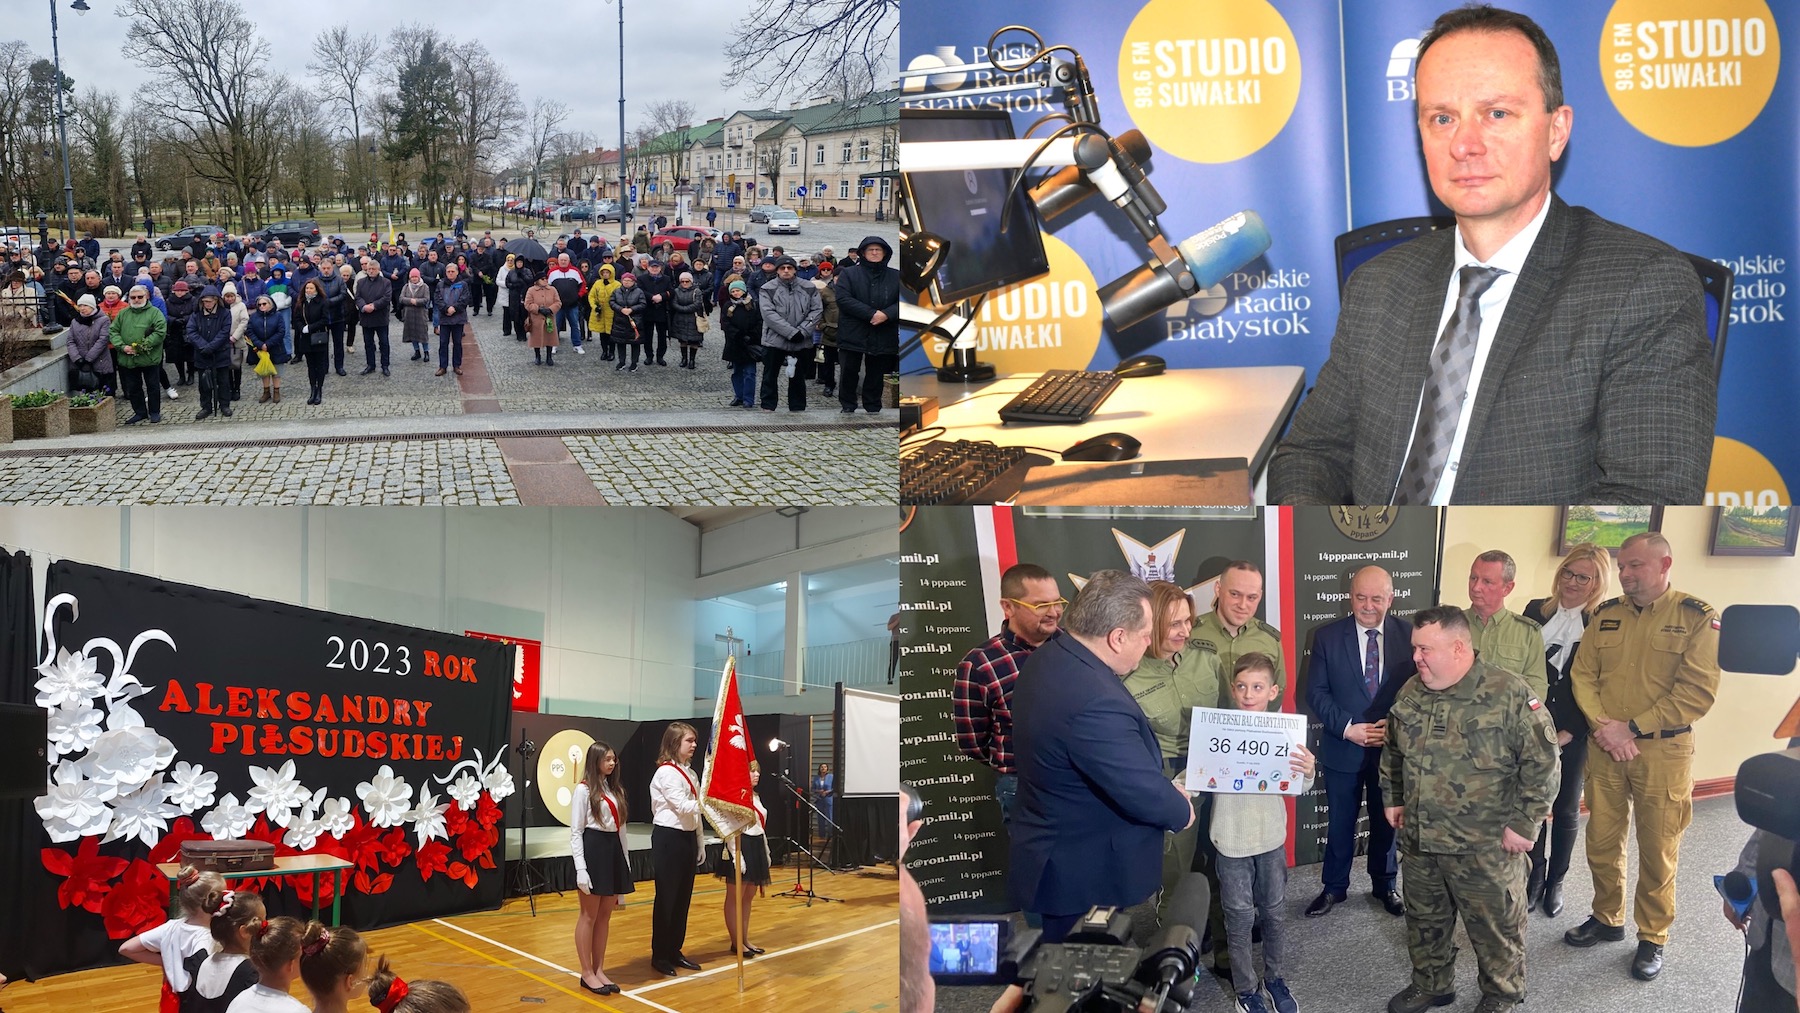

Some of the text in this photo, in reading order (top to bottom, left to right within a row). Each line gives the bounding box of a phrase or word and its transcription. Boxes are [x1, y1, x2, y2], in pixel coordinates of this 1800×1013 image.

[1636, 17, 1766, 60] STUDIO
[973, 43, 1054, 63] Polski
[1154, 36, 1286, 78] STUDIO
[1614, 23, 1636, 91] 98,6 FM
[974, 68, 1051, 88] Radio
[1132, 42, 1154, 108] 98,6 FM
[1640, 61, 1742, 90] SUWAŁKI
[1158, 80, 1261, 108] SUWAŁKI
[1233, 269, 1310, 290] Polskie
[1234, 292, 1311, 314] Radio
[1166, 312, 1310, 344] Białystok
[1358, 514, 1370, 529] 14
[1350, 529, 1378, 539] pppanc
[1318, 550, 1408, 562] 14pppanc.wp.mil.pl
[931, 580, 967, 588] pppanc
[1392, 589, 1411, 598] il.pl
[326, 636, 478, 684] 2023 ROK
[158, 679, 433, 727] ALEKSANDRY
[1200, 712, 1299, 730] IV OFICERSKI BAL CHARYTATYWNY
[209, 722, 463, 761] PIŁSUDSKIEJ
[1209, 737, 1289, 757] 36 490 zł
[552, 764, 564, 772] PPS
[741, 788, 747, 800] 7
[960, 794, 992, 804] pppanc
[964, 830, 996, 841] pppanc
[971, 869, 1002, 880] pppanc
